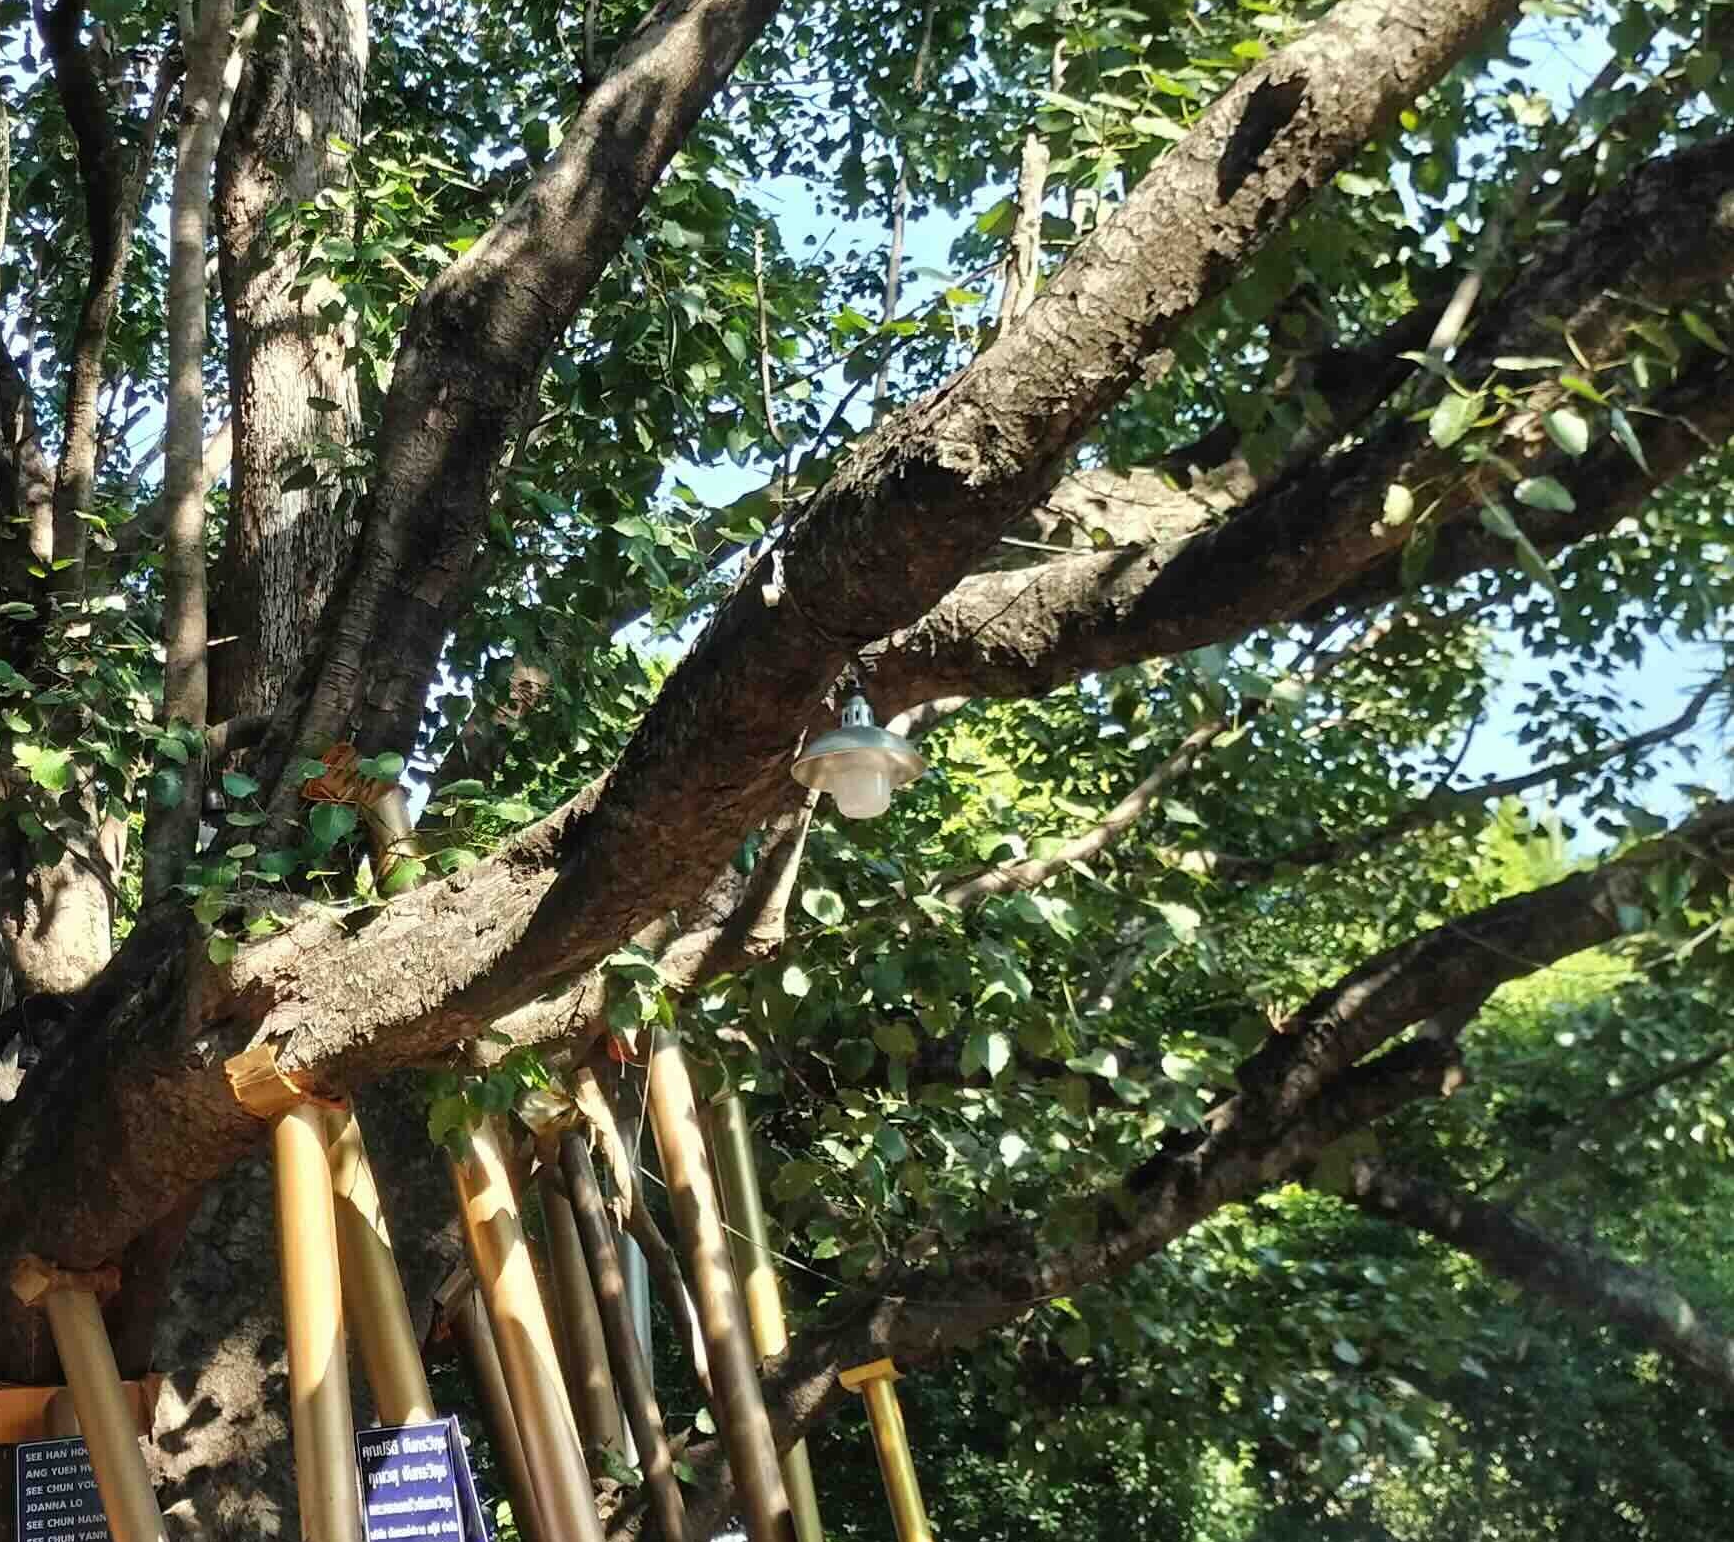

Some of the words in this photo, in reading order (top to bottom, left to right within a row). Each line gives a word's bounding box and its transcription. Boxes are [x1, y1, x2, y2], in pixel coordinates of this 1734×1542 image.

[26, 1451, 43, 1462] SEE
[26, 1467, 48, 1479] ANG
[26, 1486, 44, 1496] SEE
[46, 1482, 74, 1494] CHUN
[26, 1520, 44, 1530] SEE
[47, 1516, 75, 1528] CHUN
